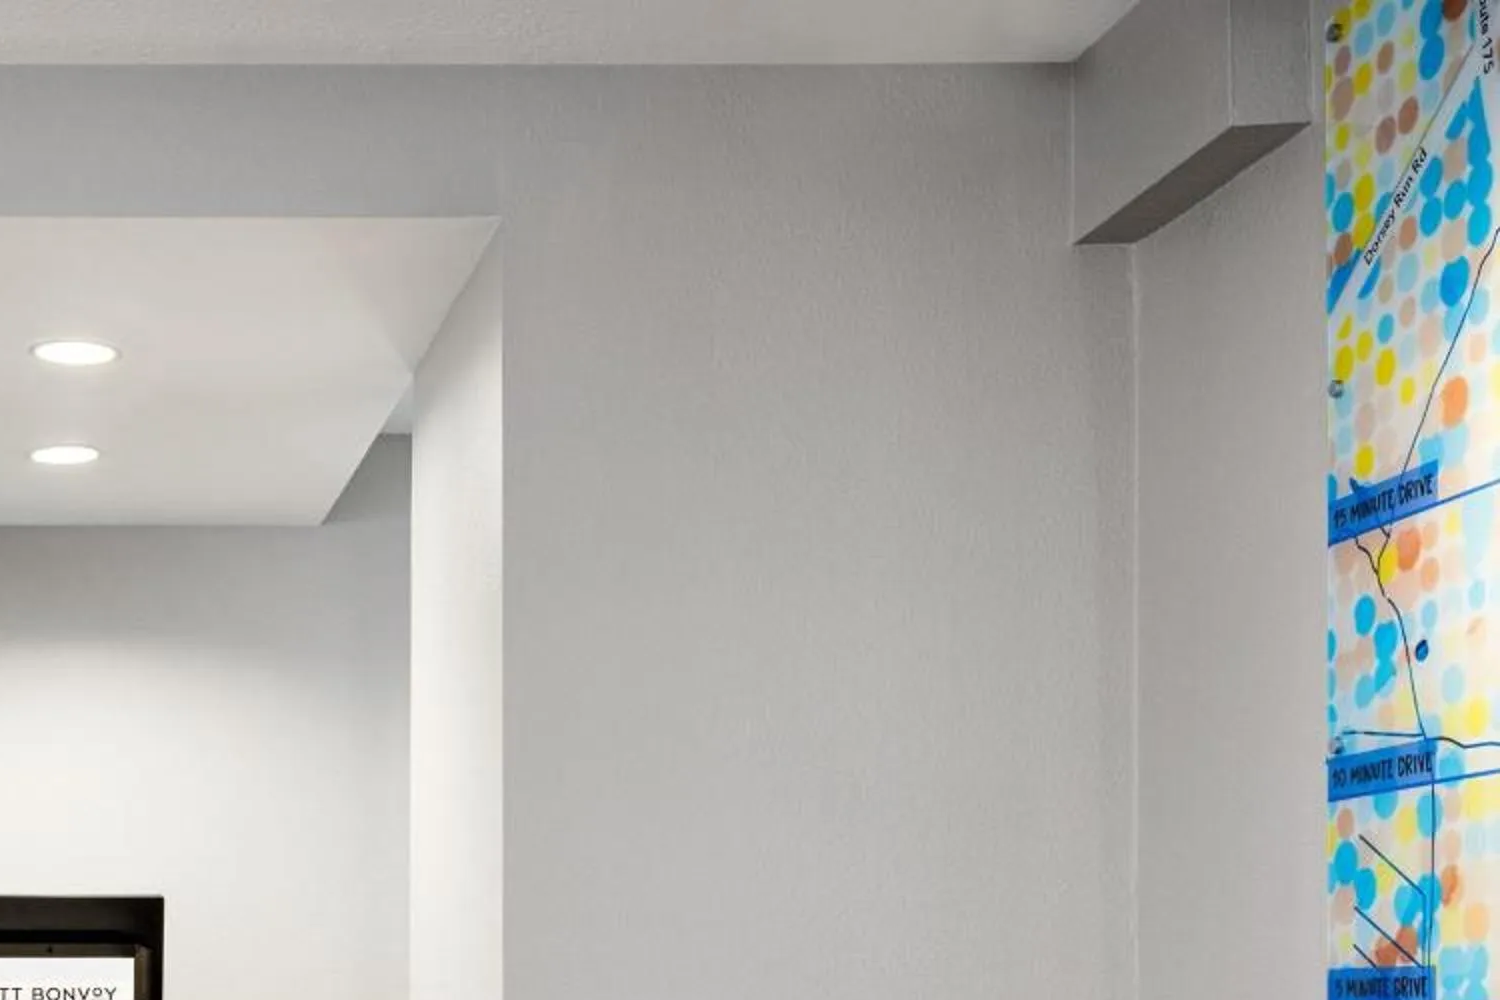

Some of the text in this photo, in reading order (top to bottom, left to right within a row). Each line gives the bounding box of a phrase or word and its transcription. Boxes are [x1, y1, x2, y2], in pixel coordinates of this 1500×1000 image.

[1482, 37, 1494, 75] 175
[1364, 146, 1428, 266] Dorsey Run Rd
[1333, 473, 1434, 529] 15 MINUTE DRIVE
[1332, 751, 1433, 789] 10 MINUTE DRIVE
[1347, 977, 1389, 998] MINUTE
[1394, 975, 1428, 998] DRIVE
